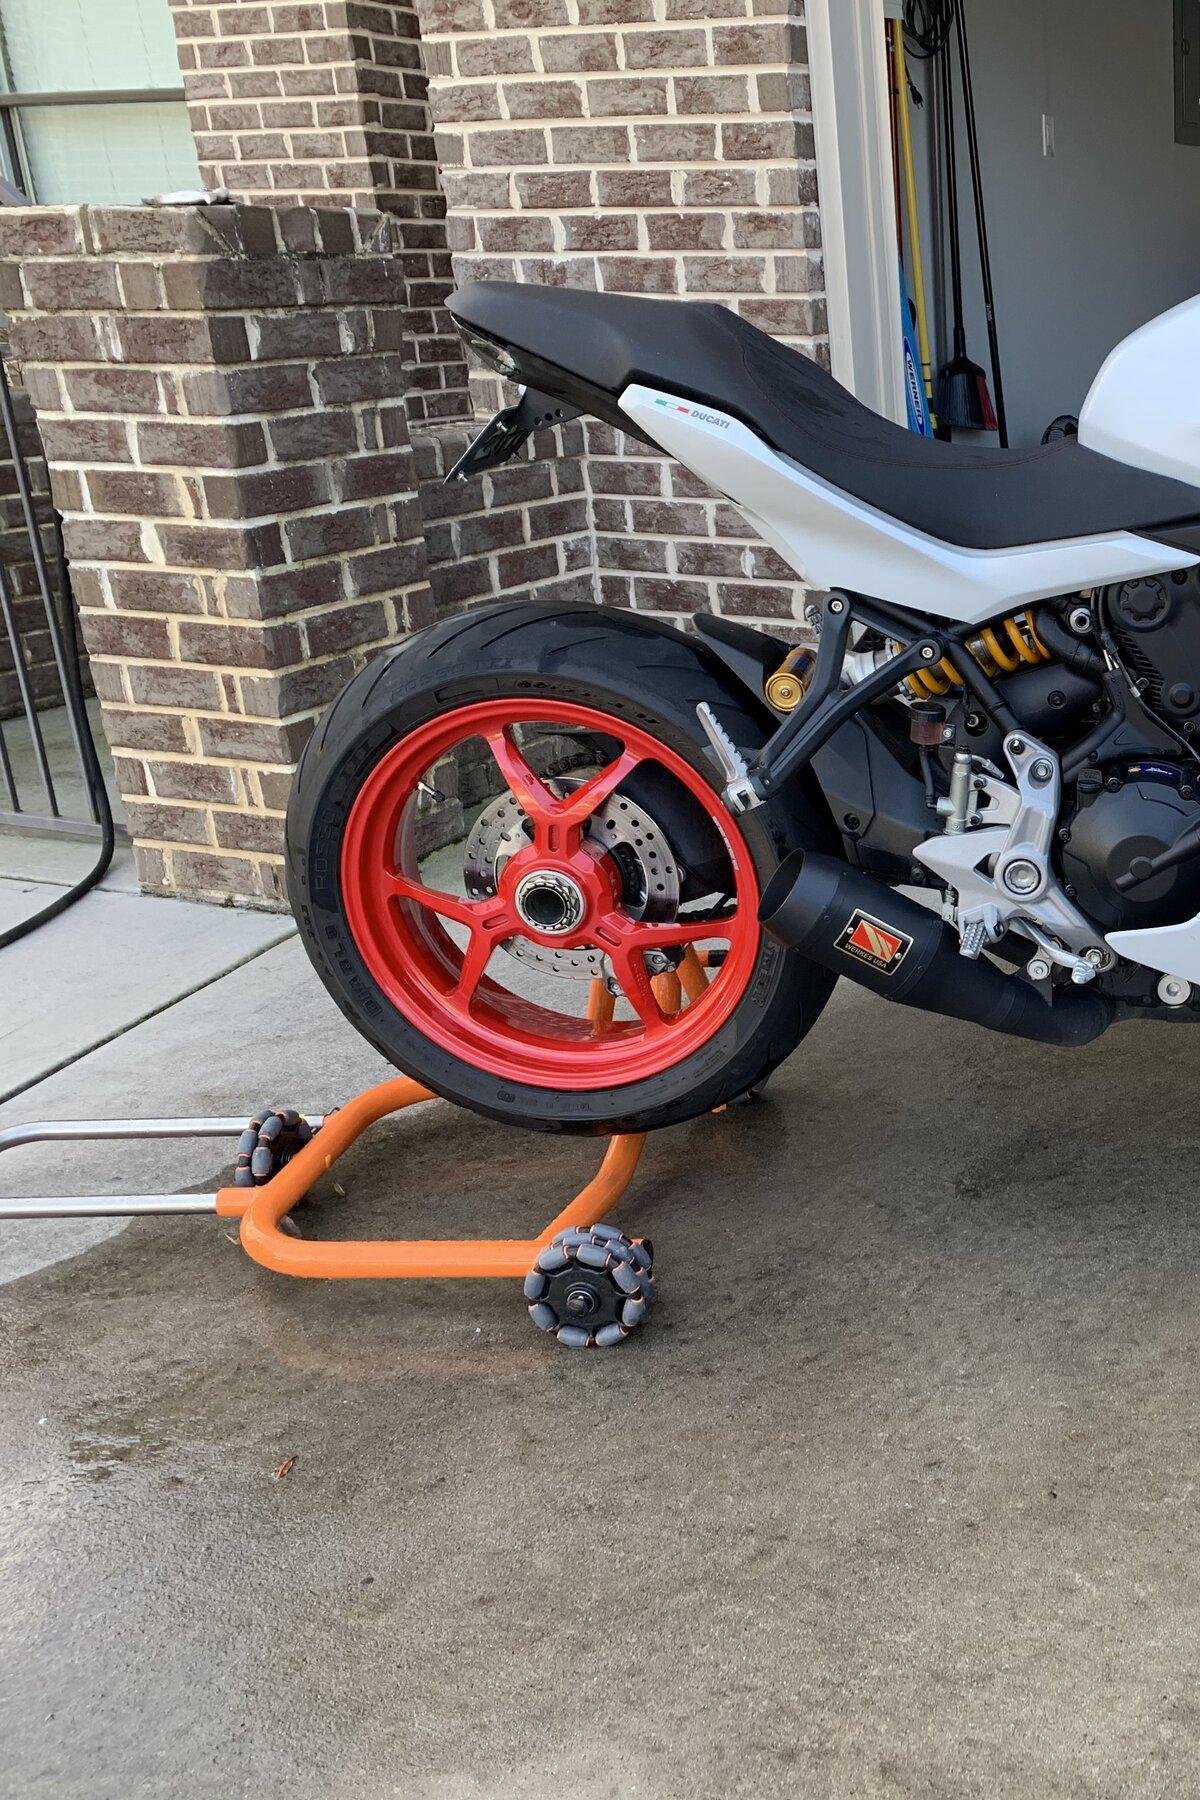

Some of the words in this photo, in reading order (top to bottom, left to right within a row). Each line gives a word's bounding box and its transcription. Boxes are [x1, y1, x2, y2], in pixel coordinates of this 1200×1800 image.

[907, 360, 922, 418] WERNER
[691, 410, 731, 429] DUCATI
[844, 943, 874, 961] WERKES
[873, 958, 887, 969] USA
